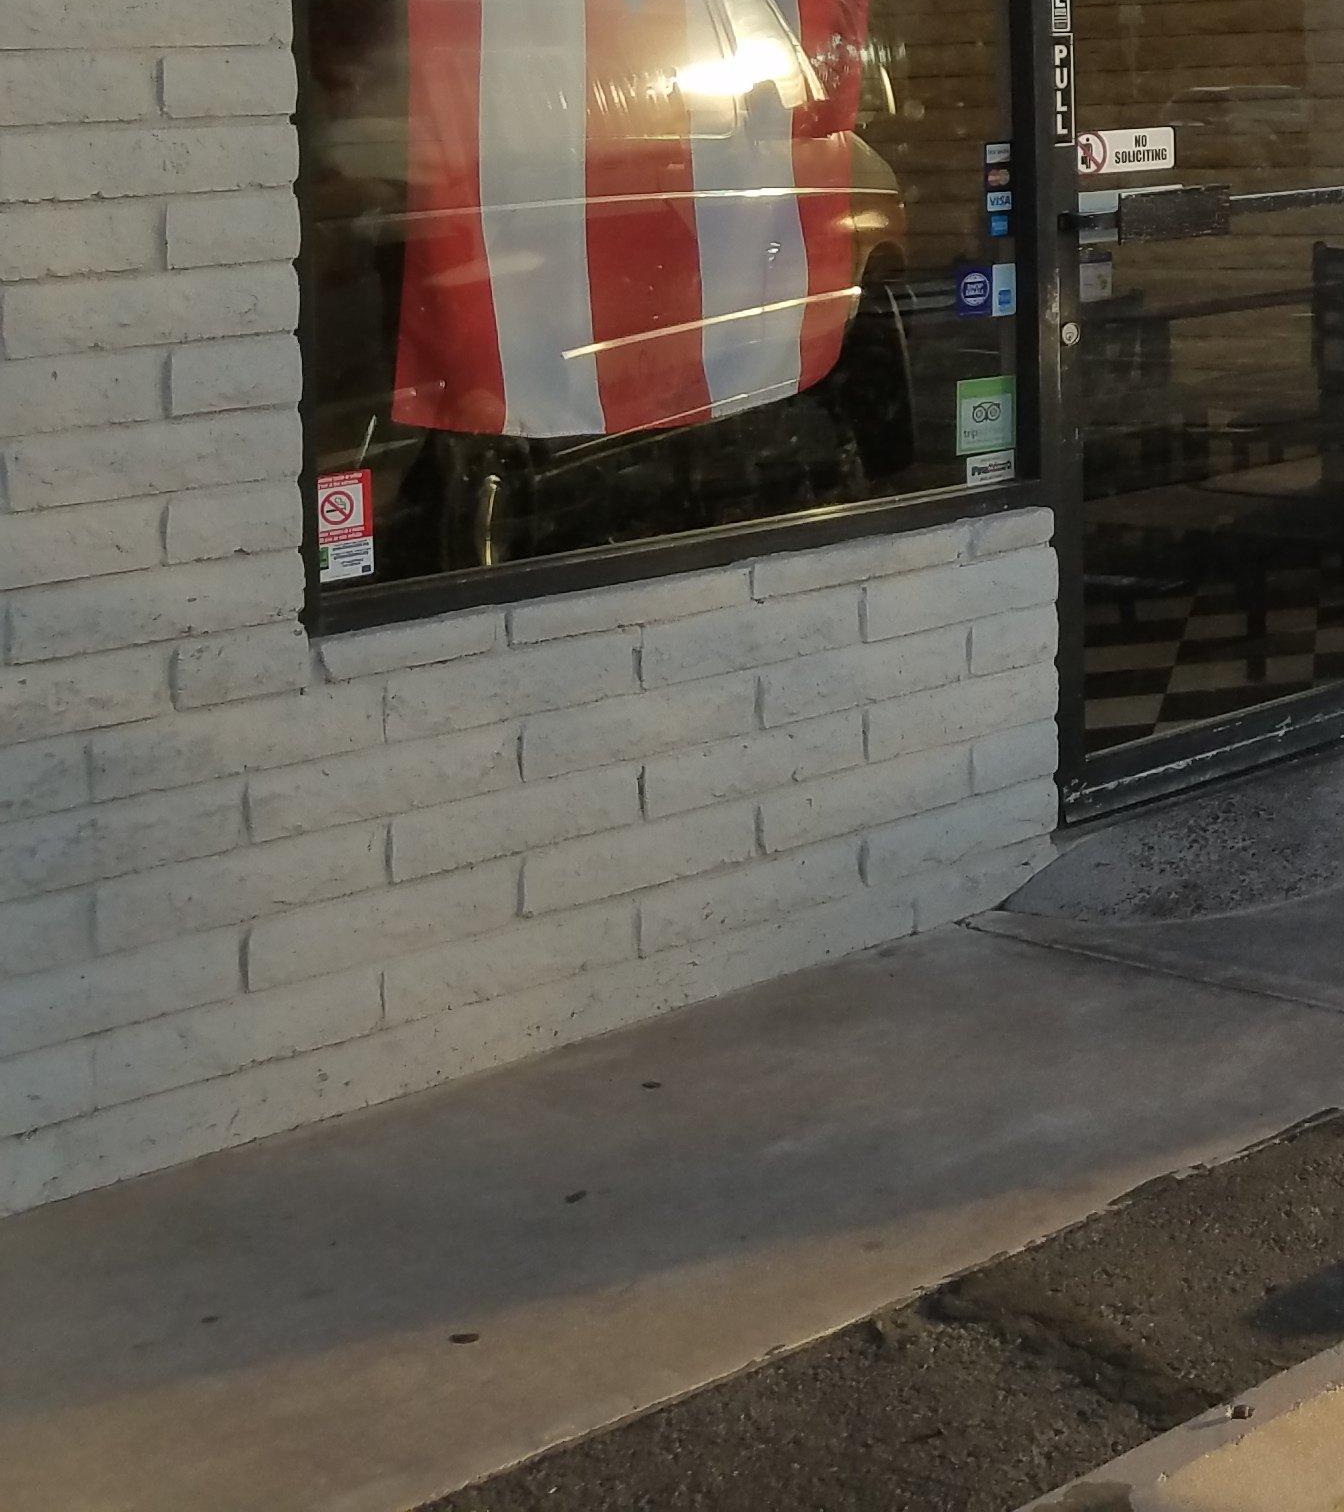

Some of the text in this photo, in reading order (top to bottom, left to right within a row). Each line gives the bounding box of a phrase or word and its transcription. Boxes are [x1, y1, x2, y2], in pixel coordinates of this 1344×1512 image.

[1054, 44, 1068, 135] PULL
[1134, 134, 1147, 148] NO
[1114, 148, 1167, 164] SOLICITING
[989, 195, 1011, 206] VISA
